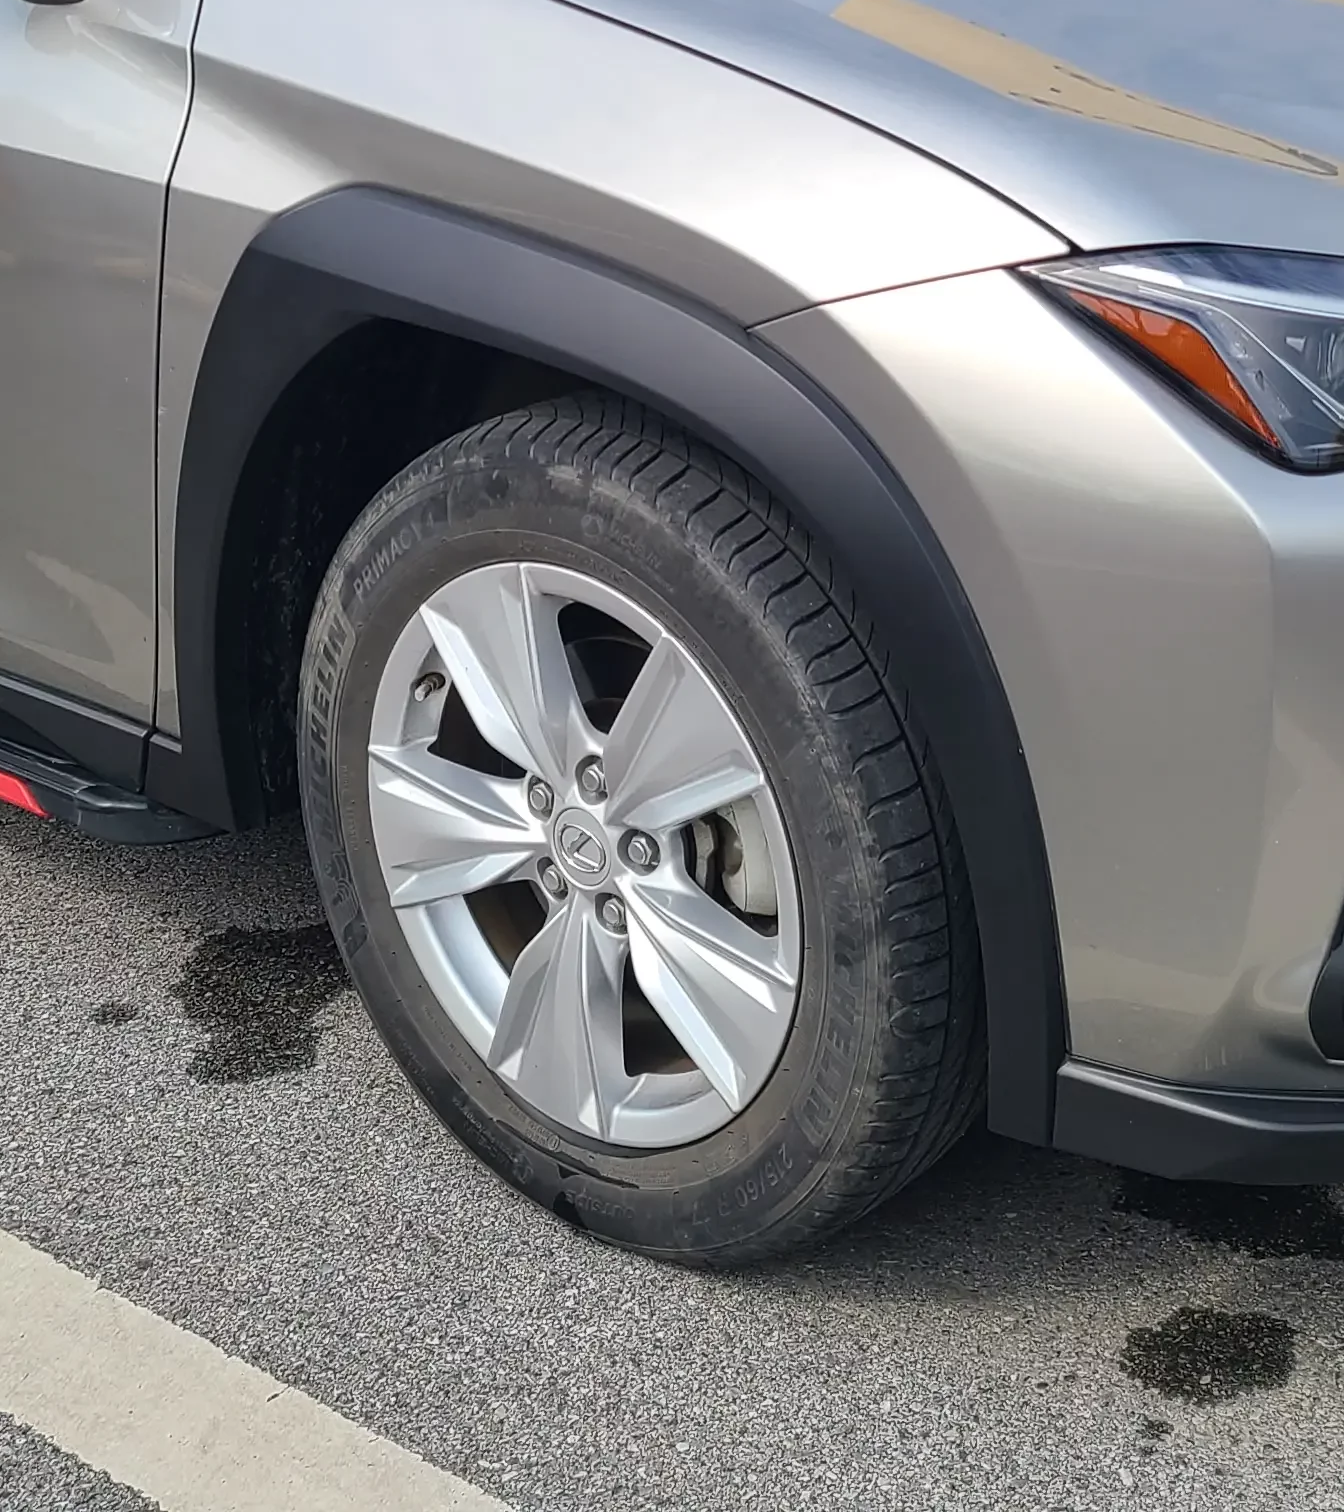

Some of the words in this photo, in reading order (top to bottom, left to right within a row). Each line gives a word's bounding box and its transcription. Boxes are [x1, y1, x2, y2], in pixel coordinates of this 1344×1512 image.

[353, 520, 423, 604] PRIMACY
[309, 612, 350, 842] MICHELIN
[733, 1142, 793, 1208] 215/60
